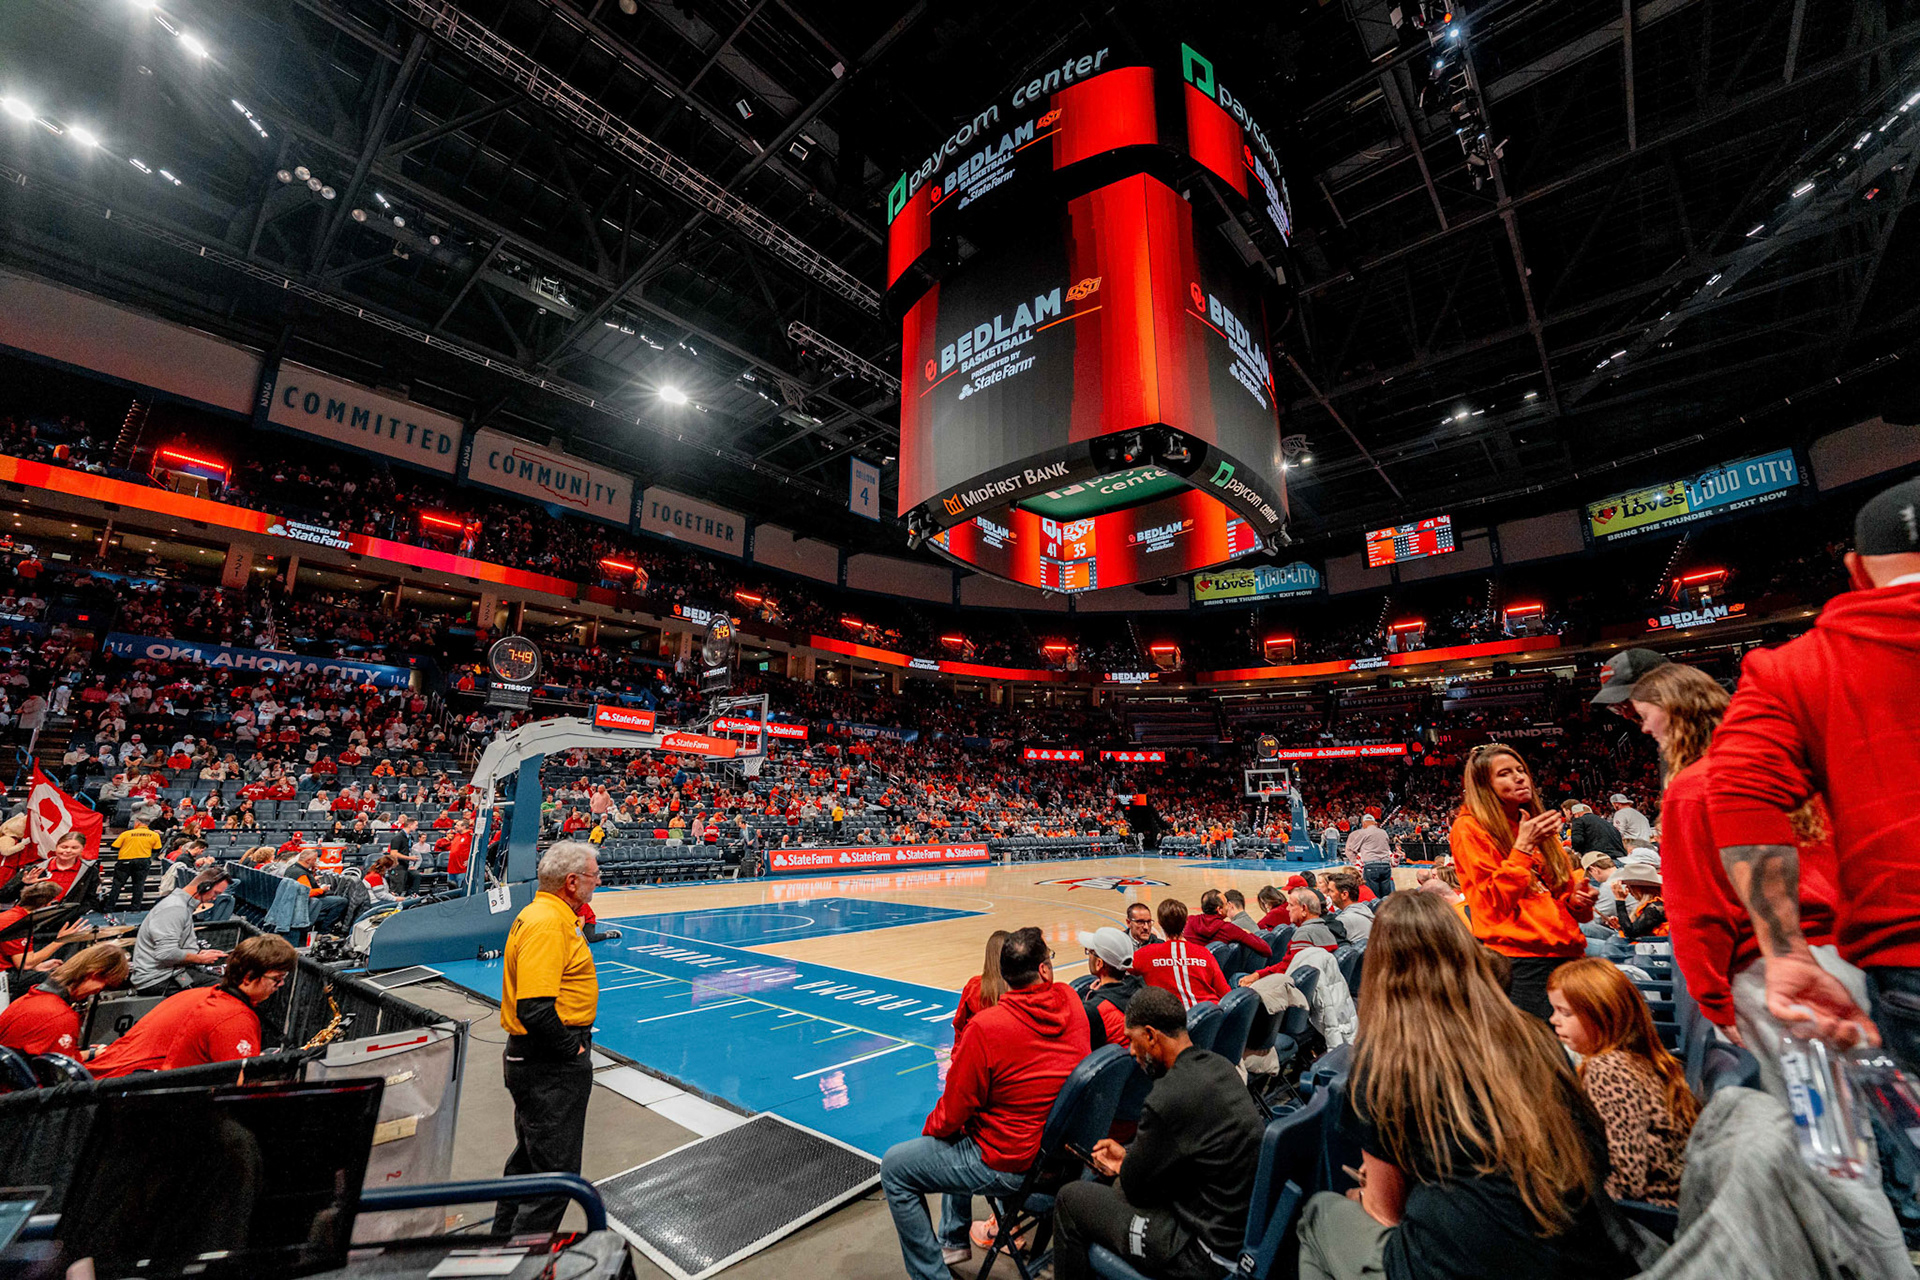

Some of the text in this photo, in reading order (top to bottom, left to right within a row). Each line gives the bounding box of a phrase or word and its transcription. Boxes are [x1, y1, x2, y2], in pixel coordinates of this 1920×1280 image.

[909, 47, 1109, 196] paycom center
[1219, 83, 1281, 177] paycom
[945, 120, 1034, 194] BEDLAM
[960, 151, 1014, 191] BASKETBALL
[941, 287, 1061, 374] BEDLAM
[1209, 293, 1271, 386] BEDLAM
[961, 330, 1033, 373] BASKETBALL
[971, 350, 1021, 380] PRESENTED BY
[284, 386, 452, 454] COMMITTED
[488, 451, 617, 505] COMMUNITY
[1690, 469, 1741, 507] LOUD
[1746, 459, 1794, 486] CITY
[860, 487, 869, 506] 4
[1223, 478, 1279, 524] paycom center
[652, 502, 734, 542] TOGETHER
[977, 515, 1010, 538] BEDLAM
[1423, 520, 1434, 528] 41
[1607, 490, 1788, 542] BRING THE THUNDER EXIT NOW
[286, 520, 341, 537] PRESENTED BY
[1136, 521, 1182, 541] BEDLAM
[1380, 529, 1392, 537] 35
[1047, 542, 1057, 557] 41
[1073, 542, 1086, 558] 35
[1291, 568, 1317, 585] CITY
[682, 606, 712, 622] BEDL
[1659, 605, 1728, 627] BEDLAM
[1675, 618, 1715, 629] BASKETBALL
[508, 649, 533, 664] 7:49
[321, 664, 382, 682] CITY
[390, 674, 407, 685] 114
[1111, 672, 1150, 680] BEDLAM
[503, 683, 532, 692] TISSOT
[1507, 683, 1544, 691] CASINO
[1486, 727, 1564, 738] THUNDER
[1152, 957, 1207, 968] SOONERS
[627, 943, 958, 1028] KLAHOMA CITY THUNDER
